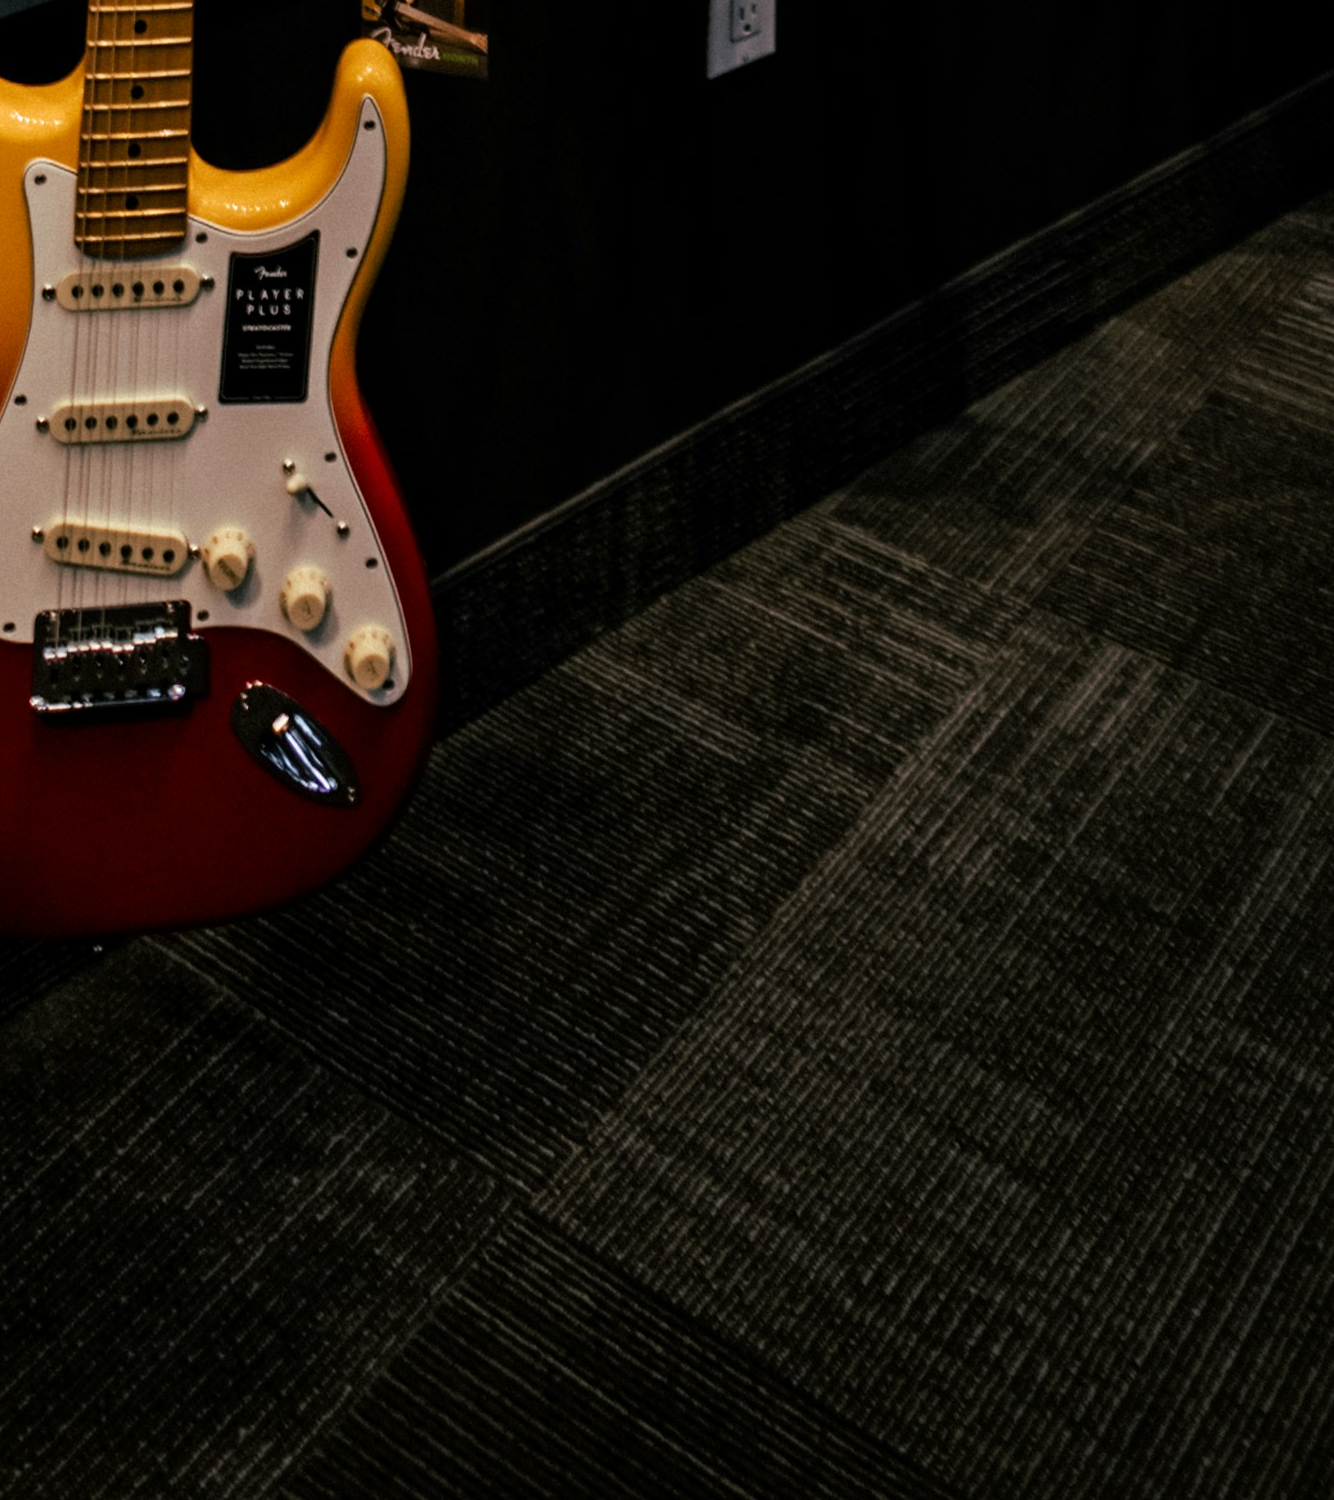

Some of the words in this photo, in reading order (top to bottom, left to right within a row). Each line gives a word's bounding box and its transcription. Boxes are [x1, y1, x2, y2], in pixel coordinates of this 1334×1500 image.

[369, 26, 442, 61] Fender
[253, 264, 288, 281] Fender
[235, 287, 305, 301] PLAYER
[246, 303, 292, 316] PLUS
